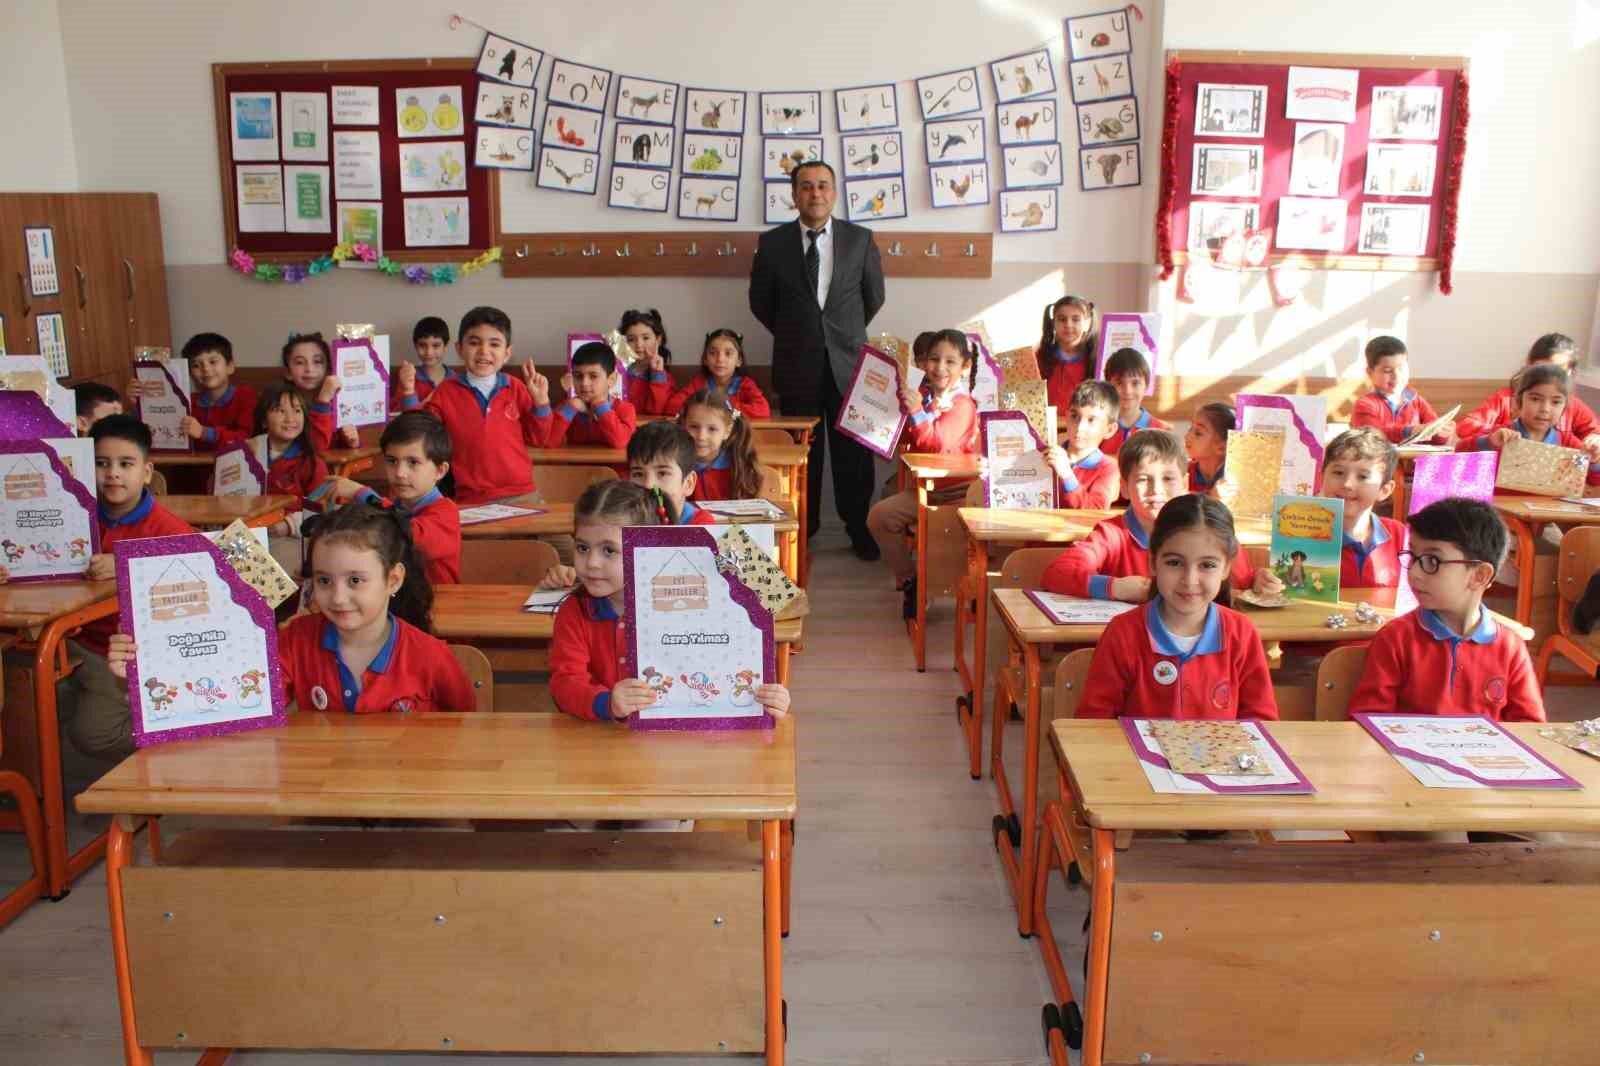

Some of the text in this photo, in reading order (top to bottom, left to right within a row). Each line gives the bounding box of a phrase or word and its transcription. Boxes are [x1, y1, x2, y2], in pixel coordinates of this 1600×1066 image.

[1075, 16, 1124, 39] u U
[521, 56, 533, 72] A
[998, 56, 1046, 82] k K
[557, 73, 605, 91] n N
[1078, 63, 1124, 85] z Z
[958, 76, 973, 92] O
[520, 94, 528, 109] R
[622, 89, 672, 104] e E
[882, 93, 893, 109] L
[729, 97, 741, 115] T
[1118, 104, 1134, 123] Ğ
[1000, 107, 1053, 127] d D
[620, 131, 671, 147] m M
[931, 125, 978, 146] y Y
[517, 136, 529, 153] Ç
[688, 139, 737, 158] ü Ü
[769, 145, 817, 160] s S
[848, 136, 898, 156] ö Ö
[545, 152, 592, 173] b B
[1009, 151, 1056, 166] v V
[1085, 150, 1134, 170] f F
[615, 174, 666, 191] g G
[935, 167, 984, 188] h H
[721, 187, 734, 202] C
[850, 184, 900, 208] p P
[1045, 193, 1052, 209] J
[169, 630, 226, 646] Doğa Mila
[179, 644, 218, 657] Yavuz
